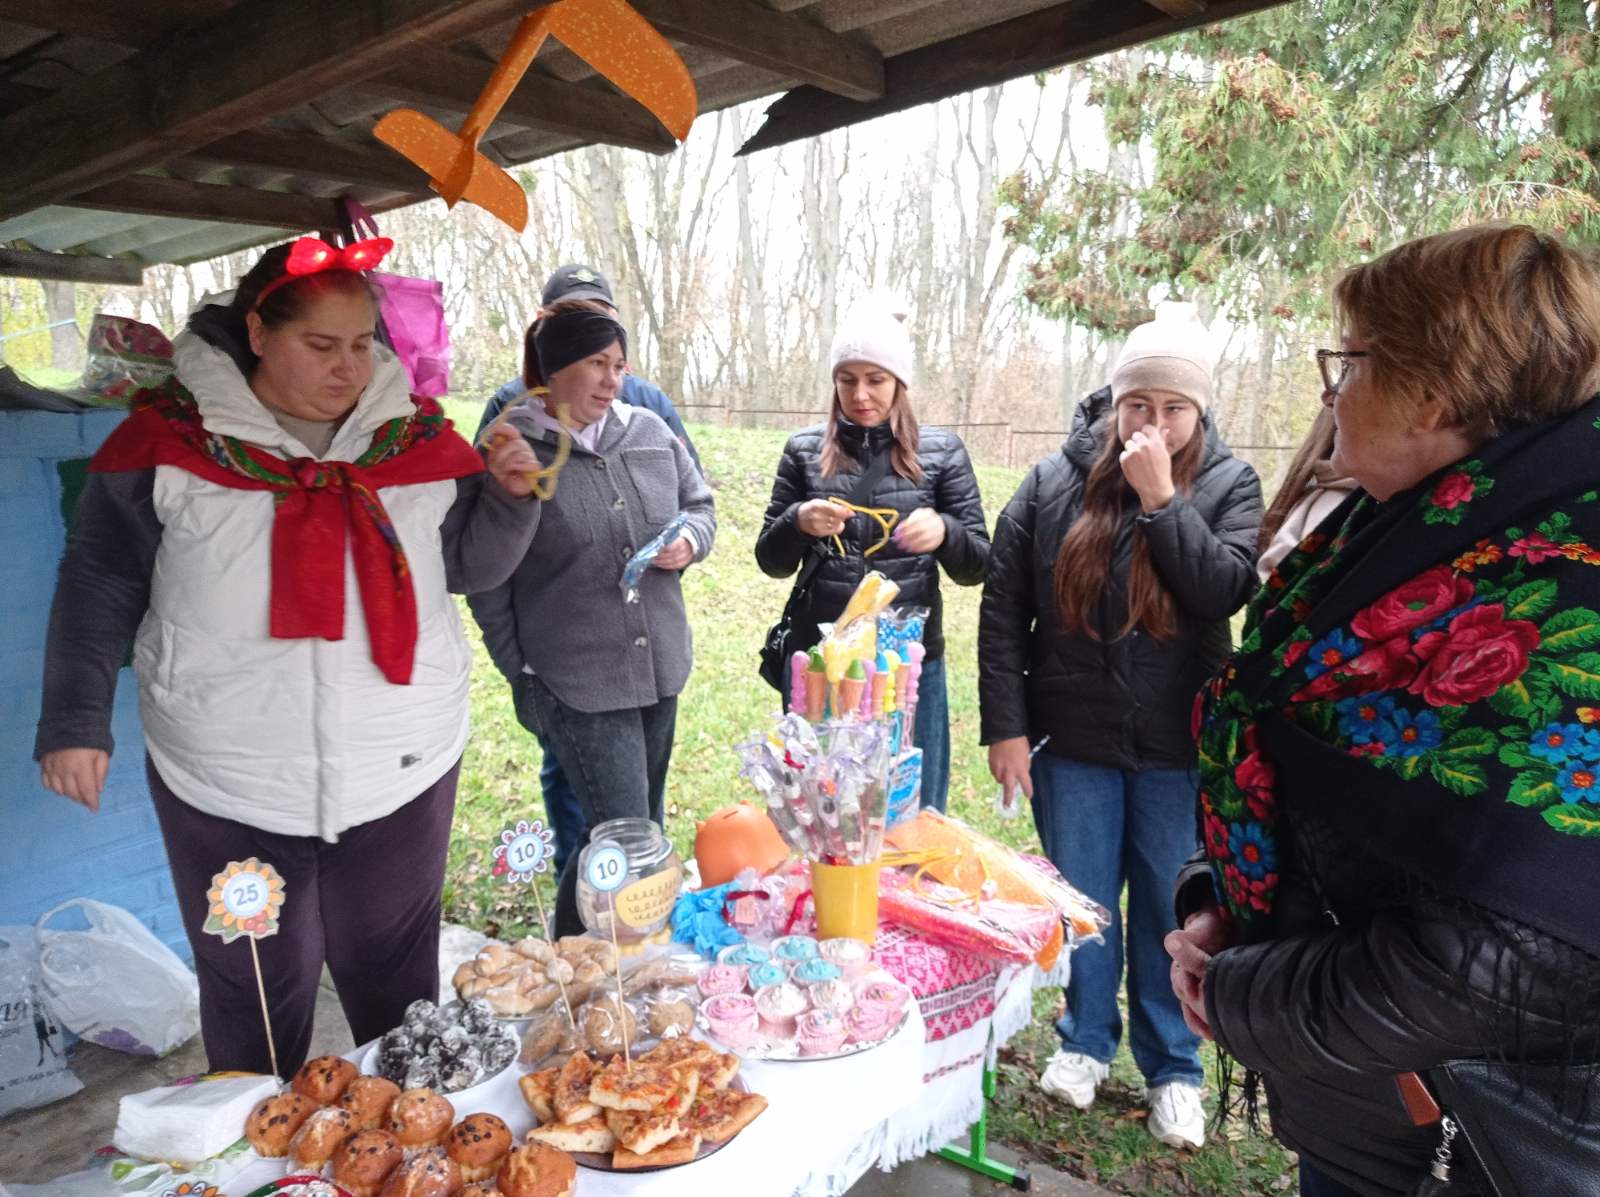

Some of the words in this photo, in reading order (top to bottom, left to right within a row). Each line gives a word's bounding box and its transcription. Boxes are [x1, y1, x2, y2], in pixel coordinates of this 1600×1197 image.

[515, 843, 535, 863] 10
[597, 859, 618, 880] 10
[233, 883, 259, 906] 25
